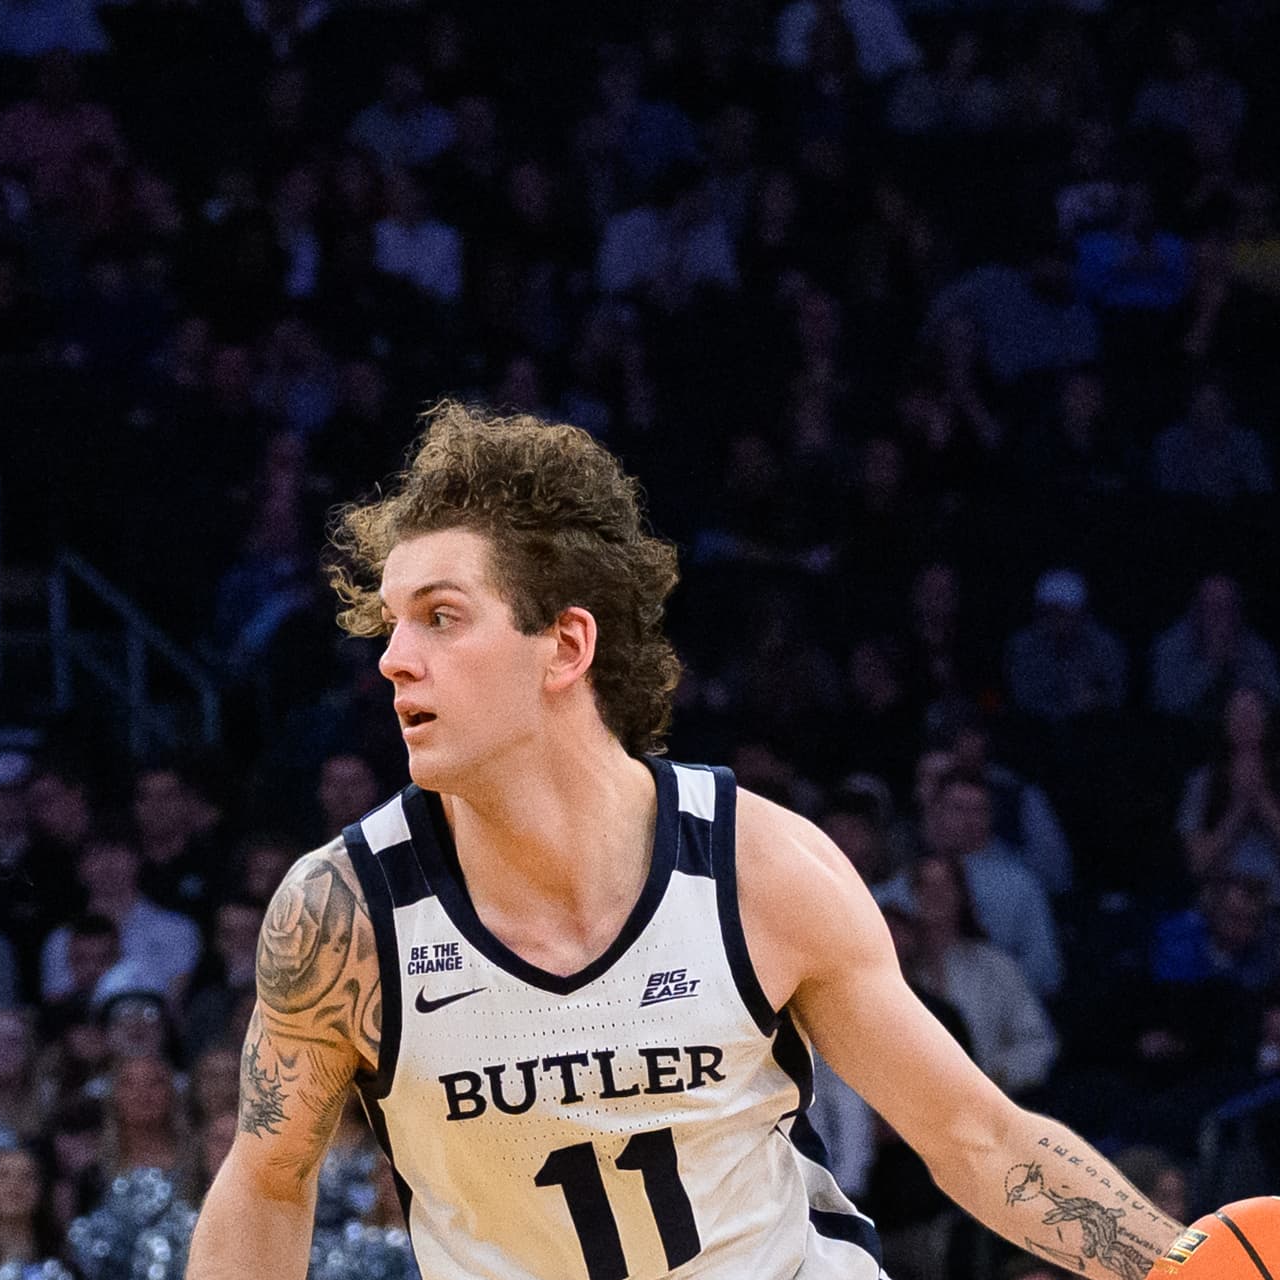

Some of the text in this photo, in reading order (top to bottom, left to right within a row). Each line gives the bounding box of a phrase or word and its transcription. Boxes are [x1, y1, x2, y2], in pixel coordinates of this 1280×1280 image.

[411, 942, 459, 961] BE THE
[407, 956, 463, 976] CHANGE
[646, 968, 687, 987] BIG
[642, 979, 701, 1001] EAST
[438, 1045, 726, 1121] BUTLER
[1038, 1137, 1184, 1237] PERSPECTI
